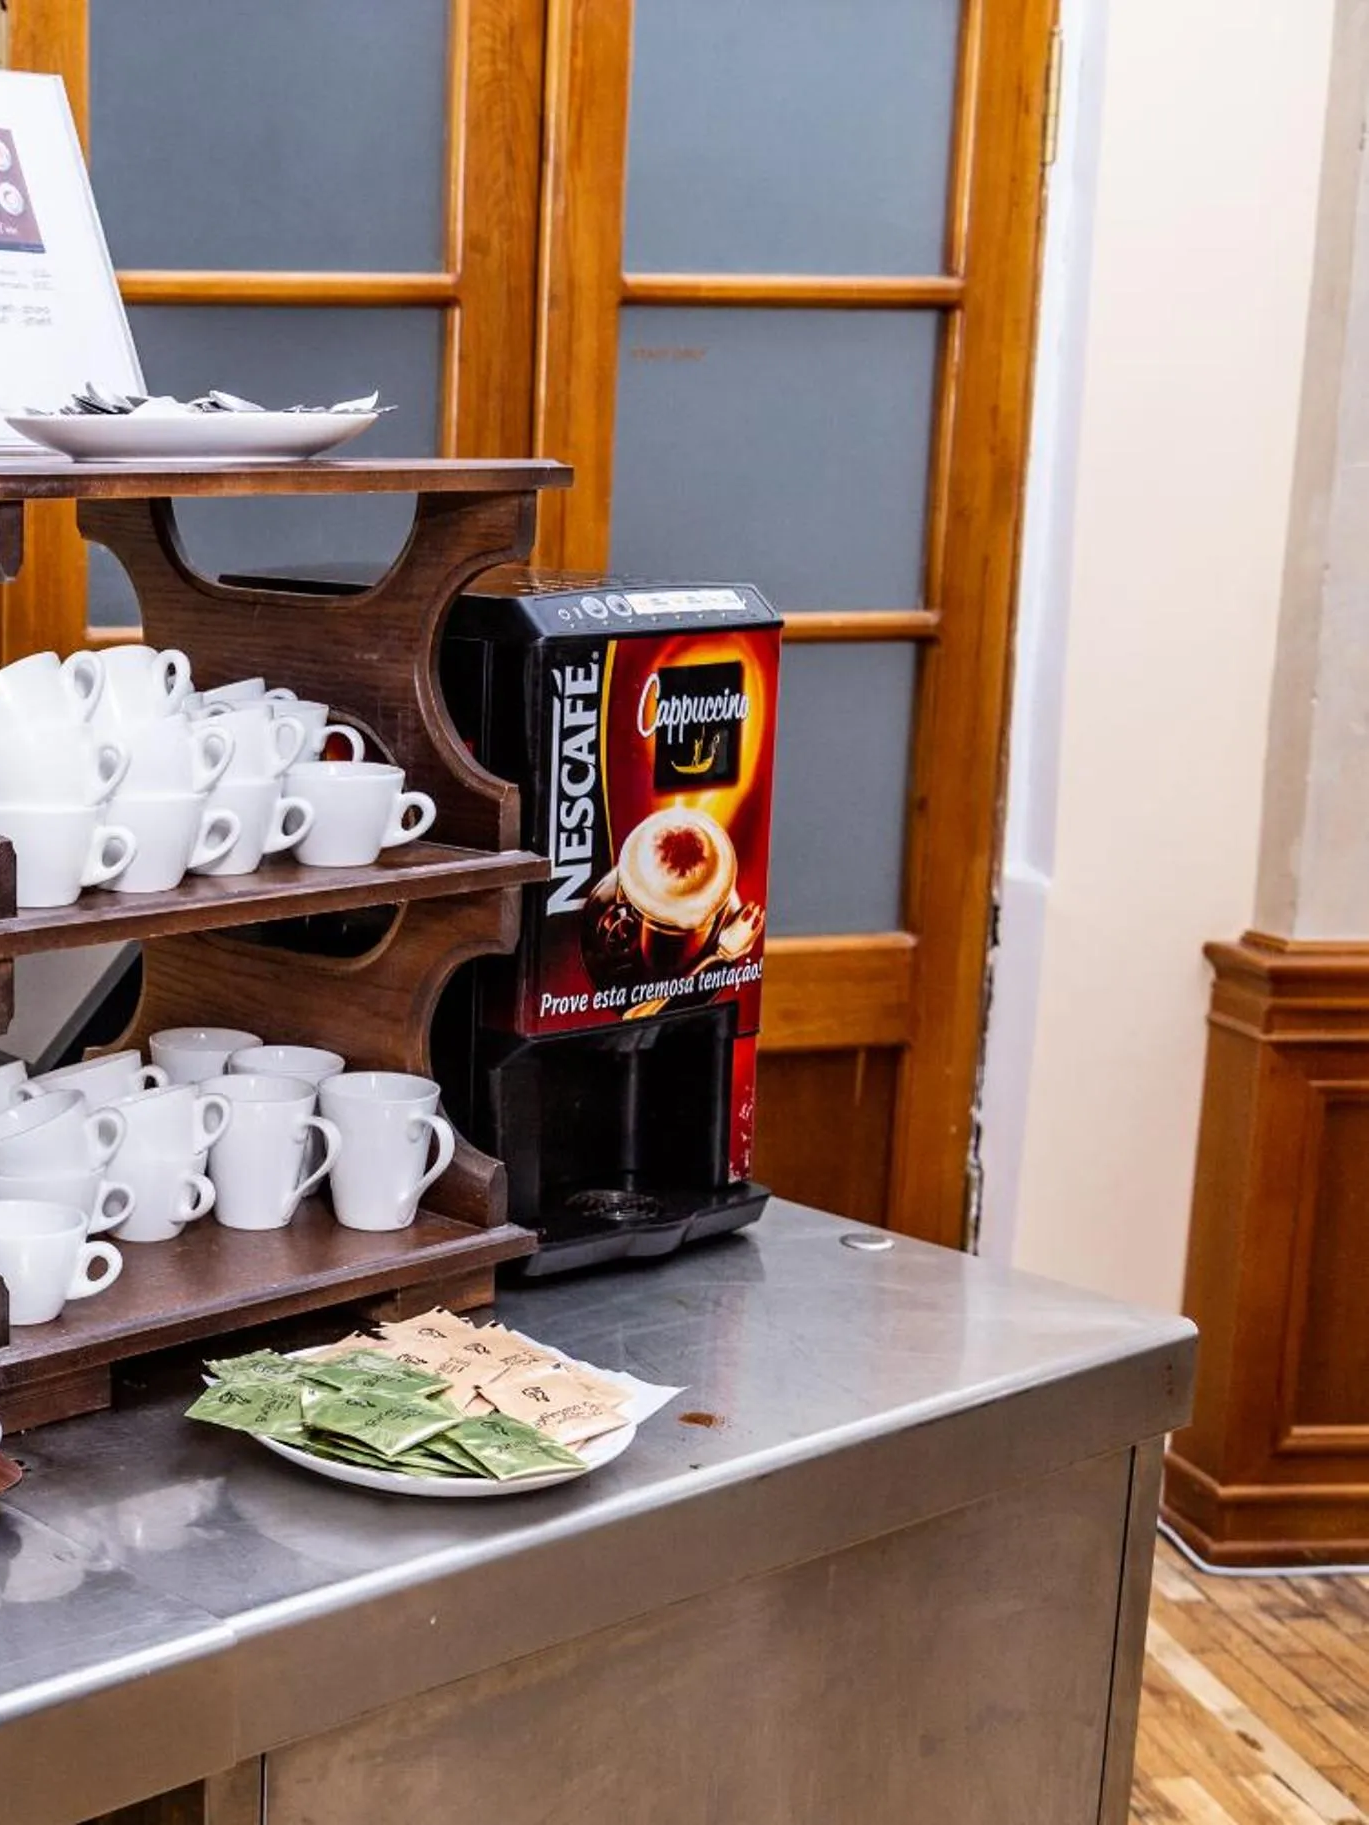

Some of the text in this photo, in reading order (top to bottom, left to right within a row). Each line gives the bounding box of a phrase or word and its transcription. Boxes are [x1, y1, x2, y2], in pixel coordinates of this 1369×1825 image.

[637, 672, 748, 745] Cappuccino
[539, 992, 588, 1018] Prove
[592, 986, 627, 1009] esta
[630, 974, 695, 1003] cremosa
